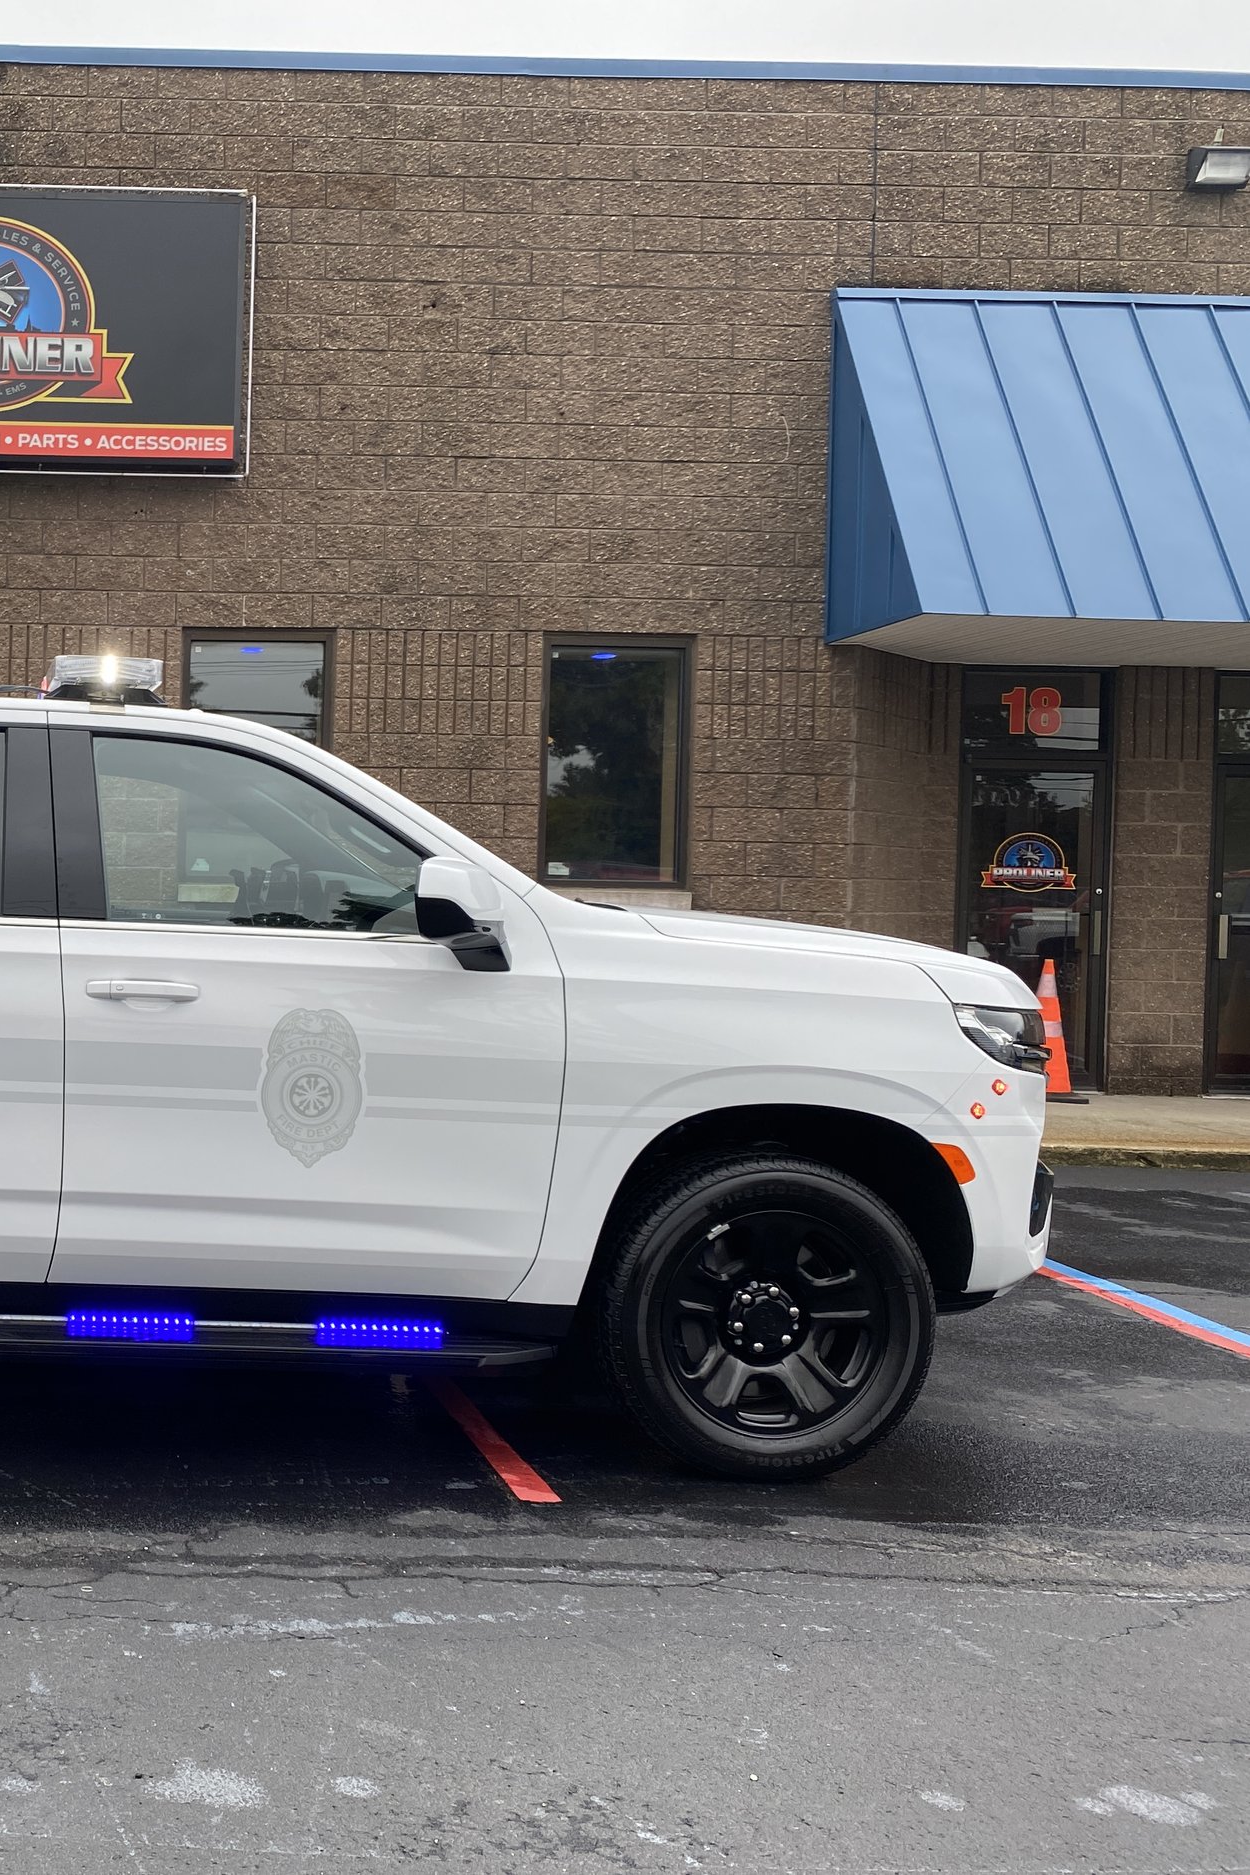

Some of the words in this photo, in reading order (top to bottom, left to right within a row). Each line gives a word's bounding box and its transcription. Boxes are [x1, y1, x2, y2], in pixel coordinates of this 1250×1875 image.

[31, 243, 41, 254] &
[44, 252, 80, 310] SERVICE
[5, 382, 27, 396] EMS
[17, 433, 79, 448] PARTS
[97, 435, 227, 452] ACCESSORIES
[1001, 686, 1062, 736] 18
[992, 867, 1066, 881] PROLINER
[287, 1039, 341, 1050] CHIEF
[287, 1053, 342, 1072] MASTIC
[277, 1114, 303, 1136] FIRE
